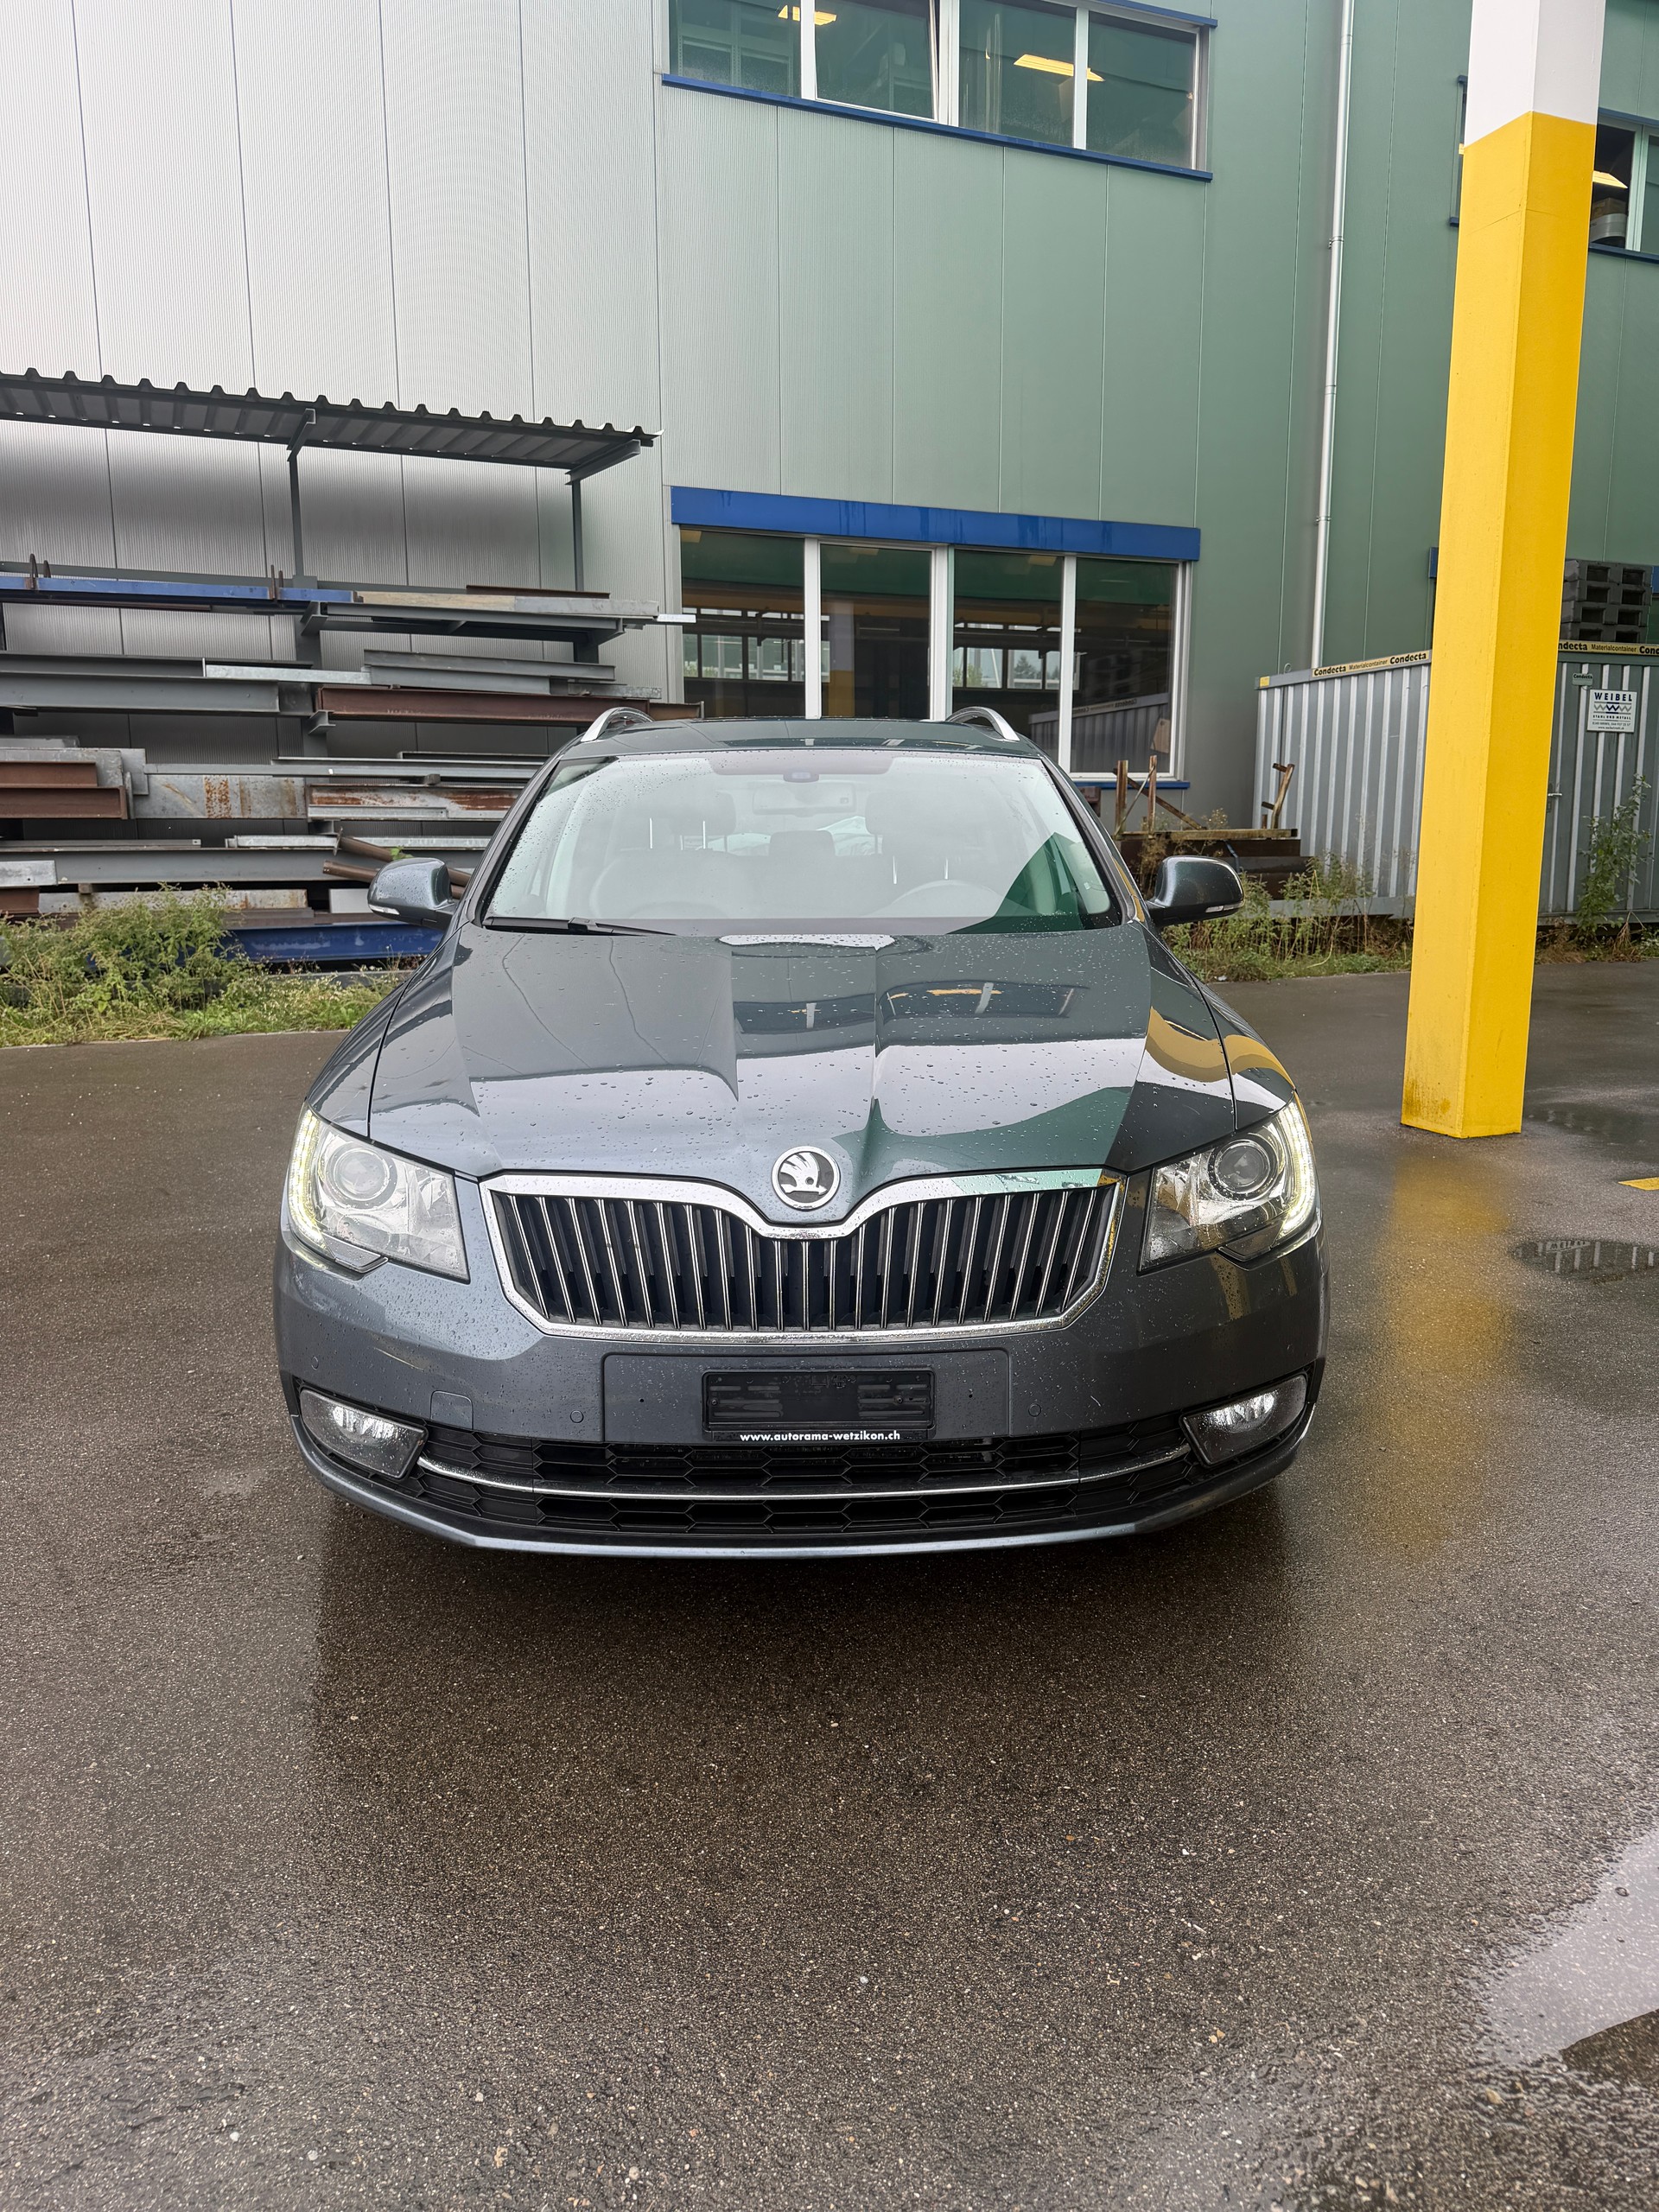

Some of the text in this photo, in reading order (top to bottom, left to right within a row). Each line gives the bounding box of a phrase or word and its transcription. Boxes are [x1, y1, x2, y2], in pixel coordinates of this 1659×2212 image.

[1558, 641, 1588, 651] ndecta
[1591, 644, 1637, 652] Materialcontainer
[1313, 652, 1427, 677] Condecta Materialcontainer Condecta
[1593, 692, 1632, 702] WEIBEL
[740, 1430, 900, 1441] www.autorama-wetzikon.ch
